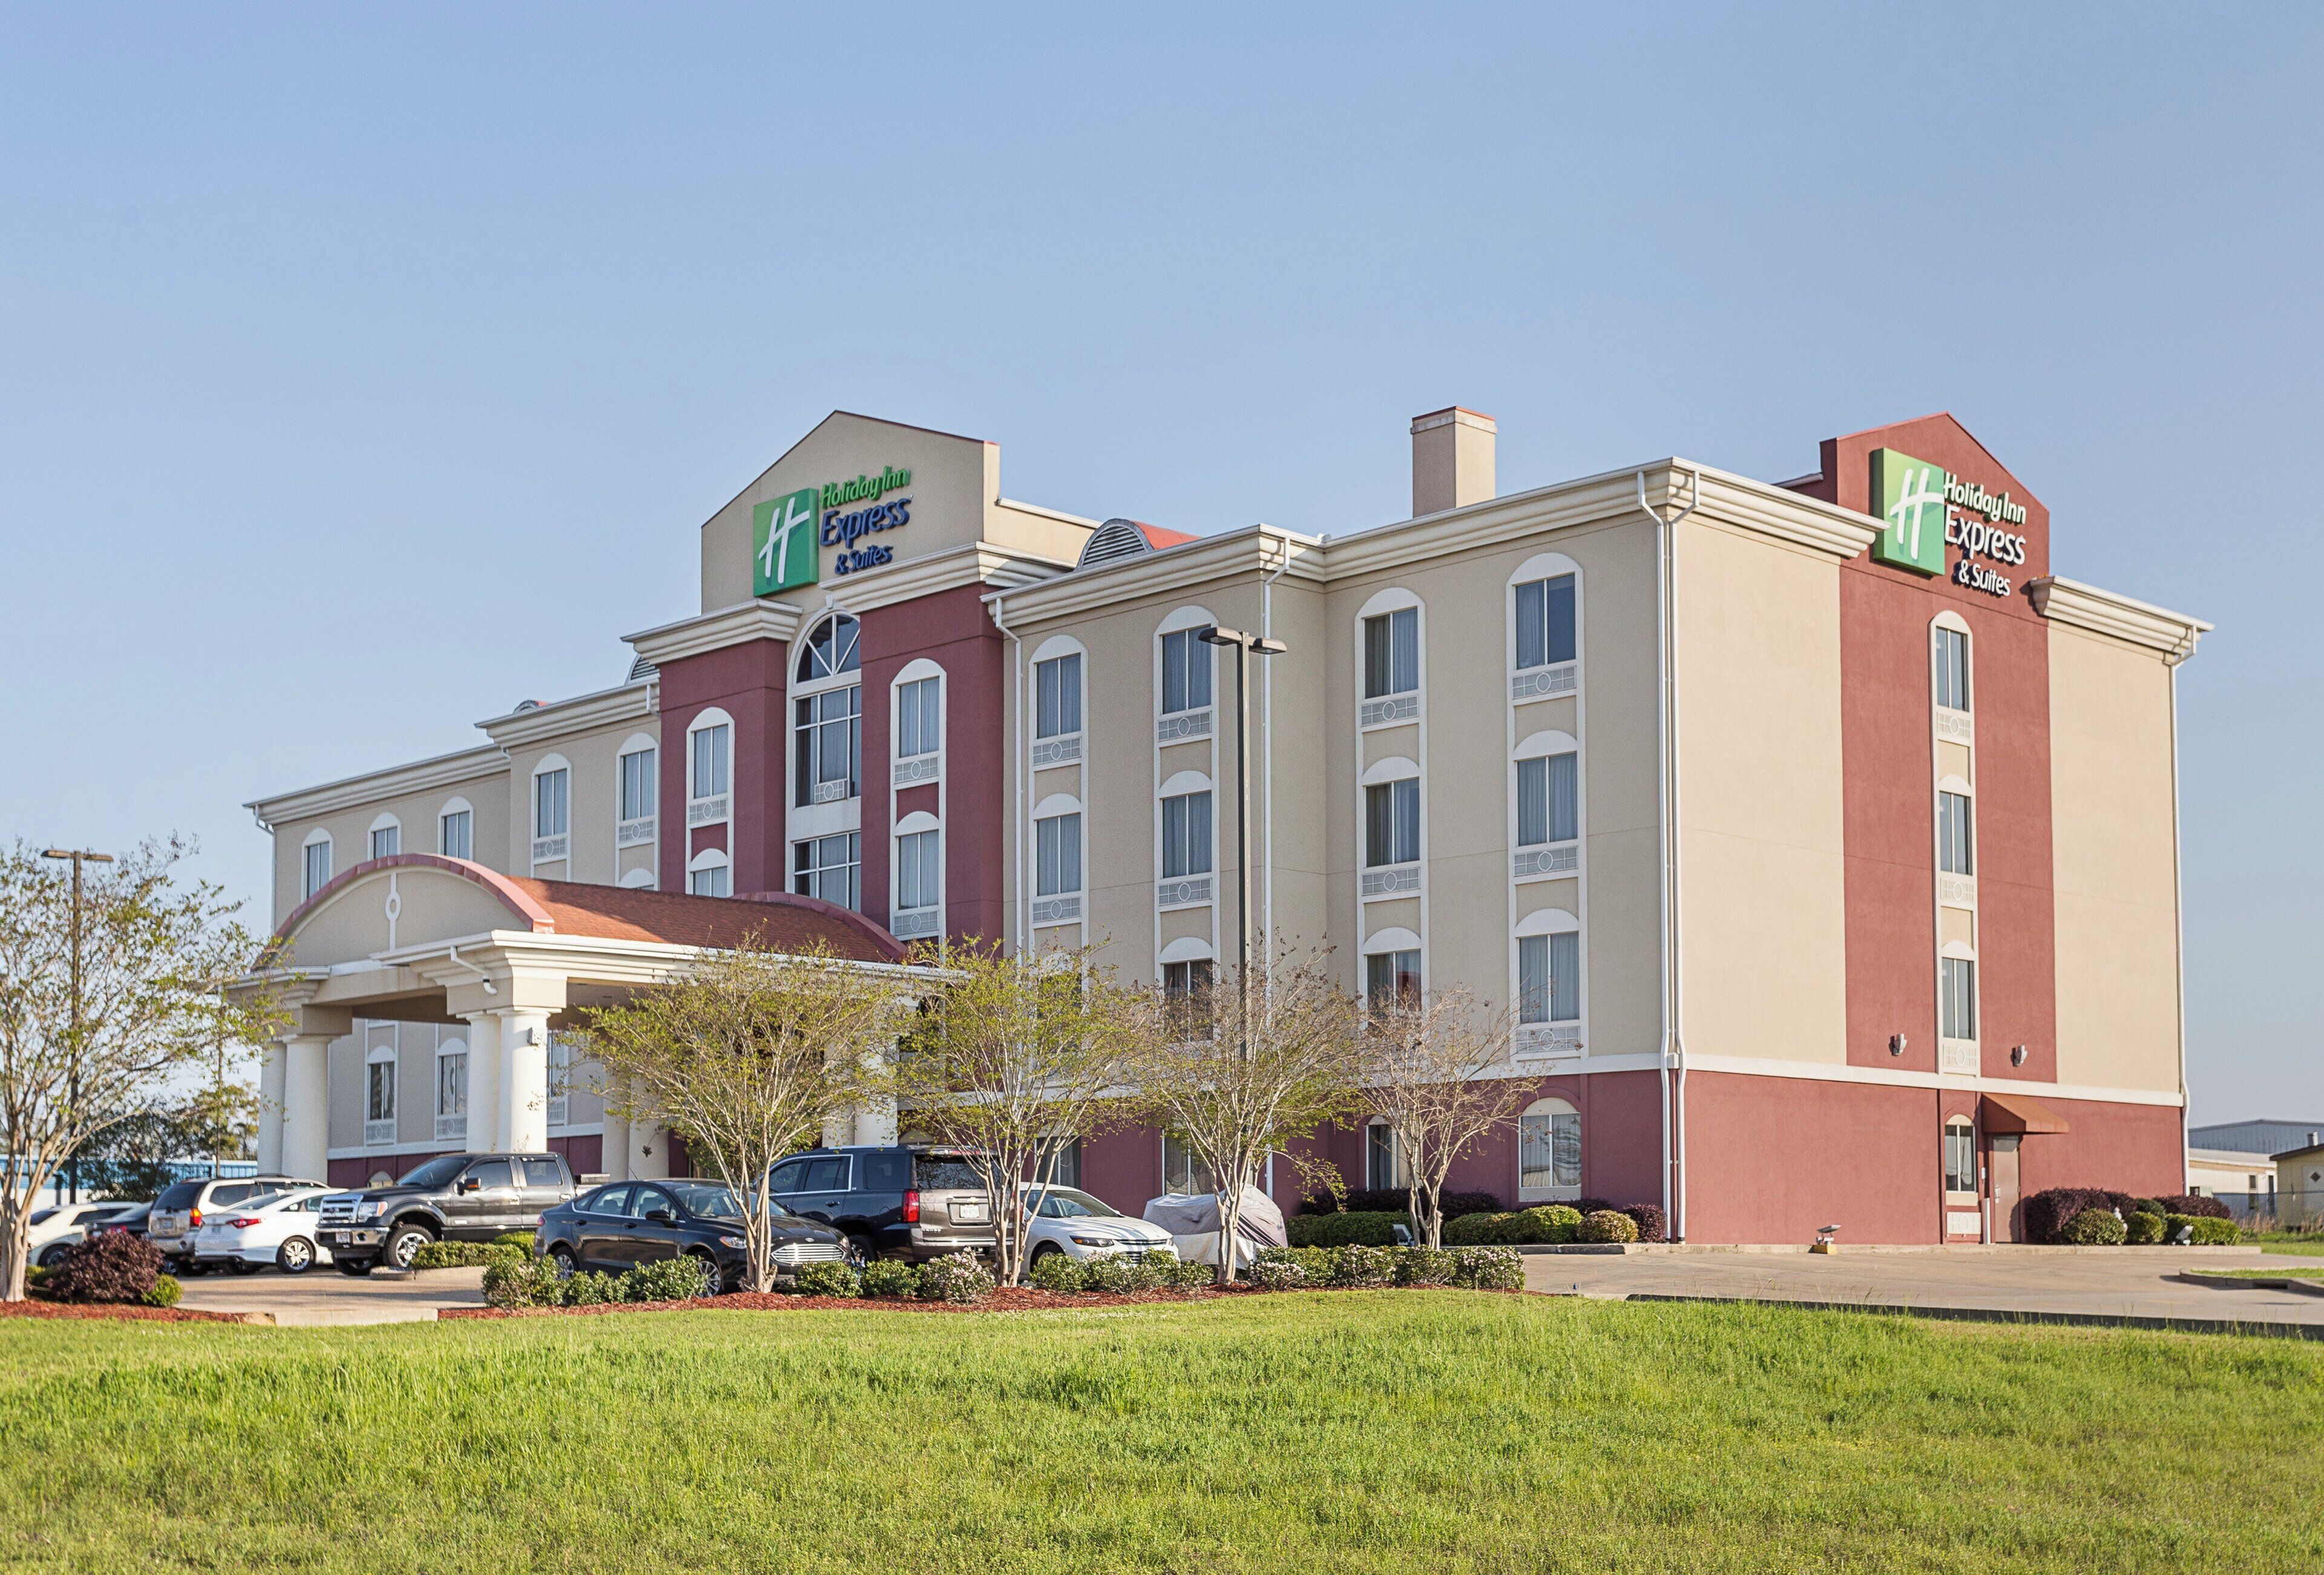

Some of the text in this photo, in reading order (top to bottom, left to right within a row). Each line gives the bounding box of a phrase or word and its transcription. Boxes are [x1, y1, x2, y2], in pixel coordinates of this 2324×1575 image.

[820, 465, 910, 509] Holiday Inn
[1943, 471, 2026, 524] Holiday Inn
[819, 498, 911, 548] Express
[1944, 504, 2026, 565] Express
[835, 545, 893, 575] & Suites
[1958, 559, 2011, 596] & Suites
